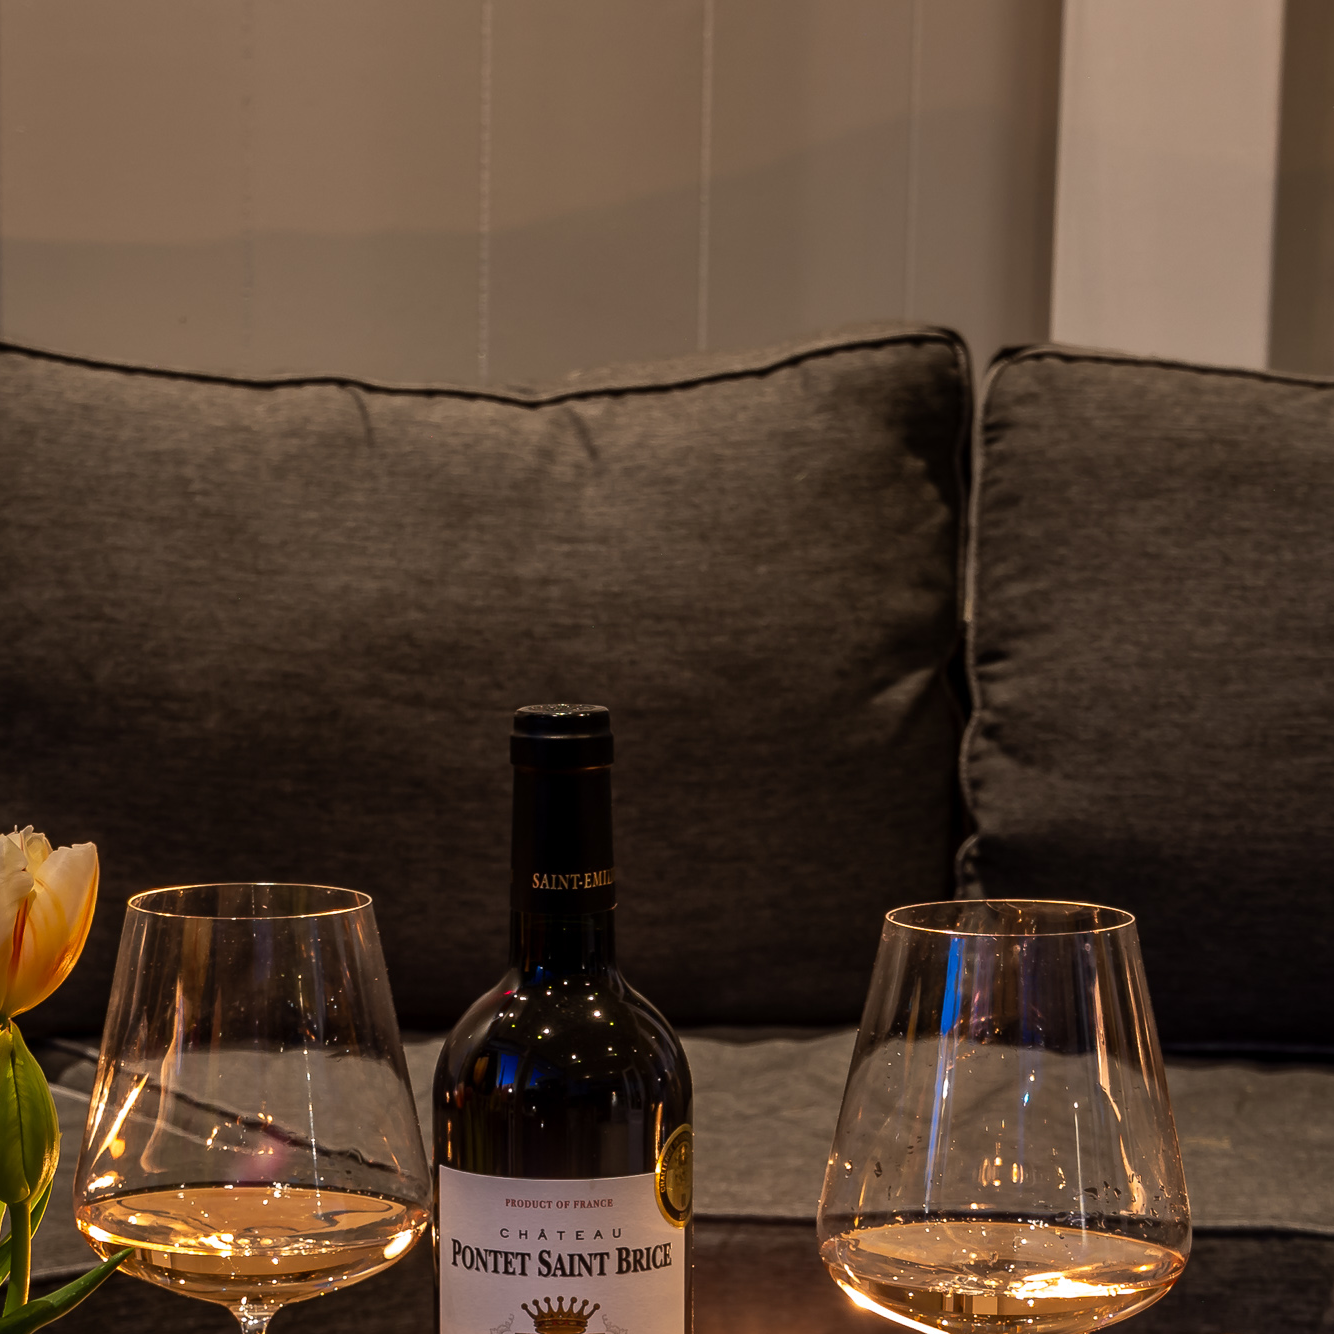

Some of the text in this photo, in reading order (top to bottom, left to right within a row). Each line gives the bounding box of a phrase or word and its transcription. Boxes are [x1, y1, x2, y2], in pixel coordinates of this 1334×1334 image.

[505, 1198, 614, 1209] PRODUCT OF FRANCE
[499, 1228, 622, 1241] CHÂTEAU
[451, 1238, 672, 1278] PONTET SAINT BRICE
